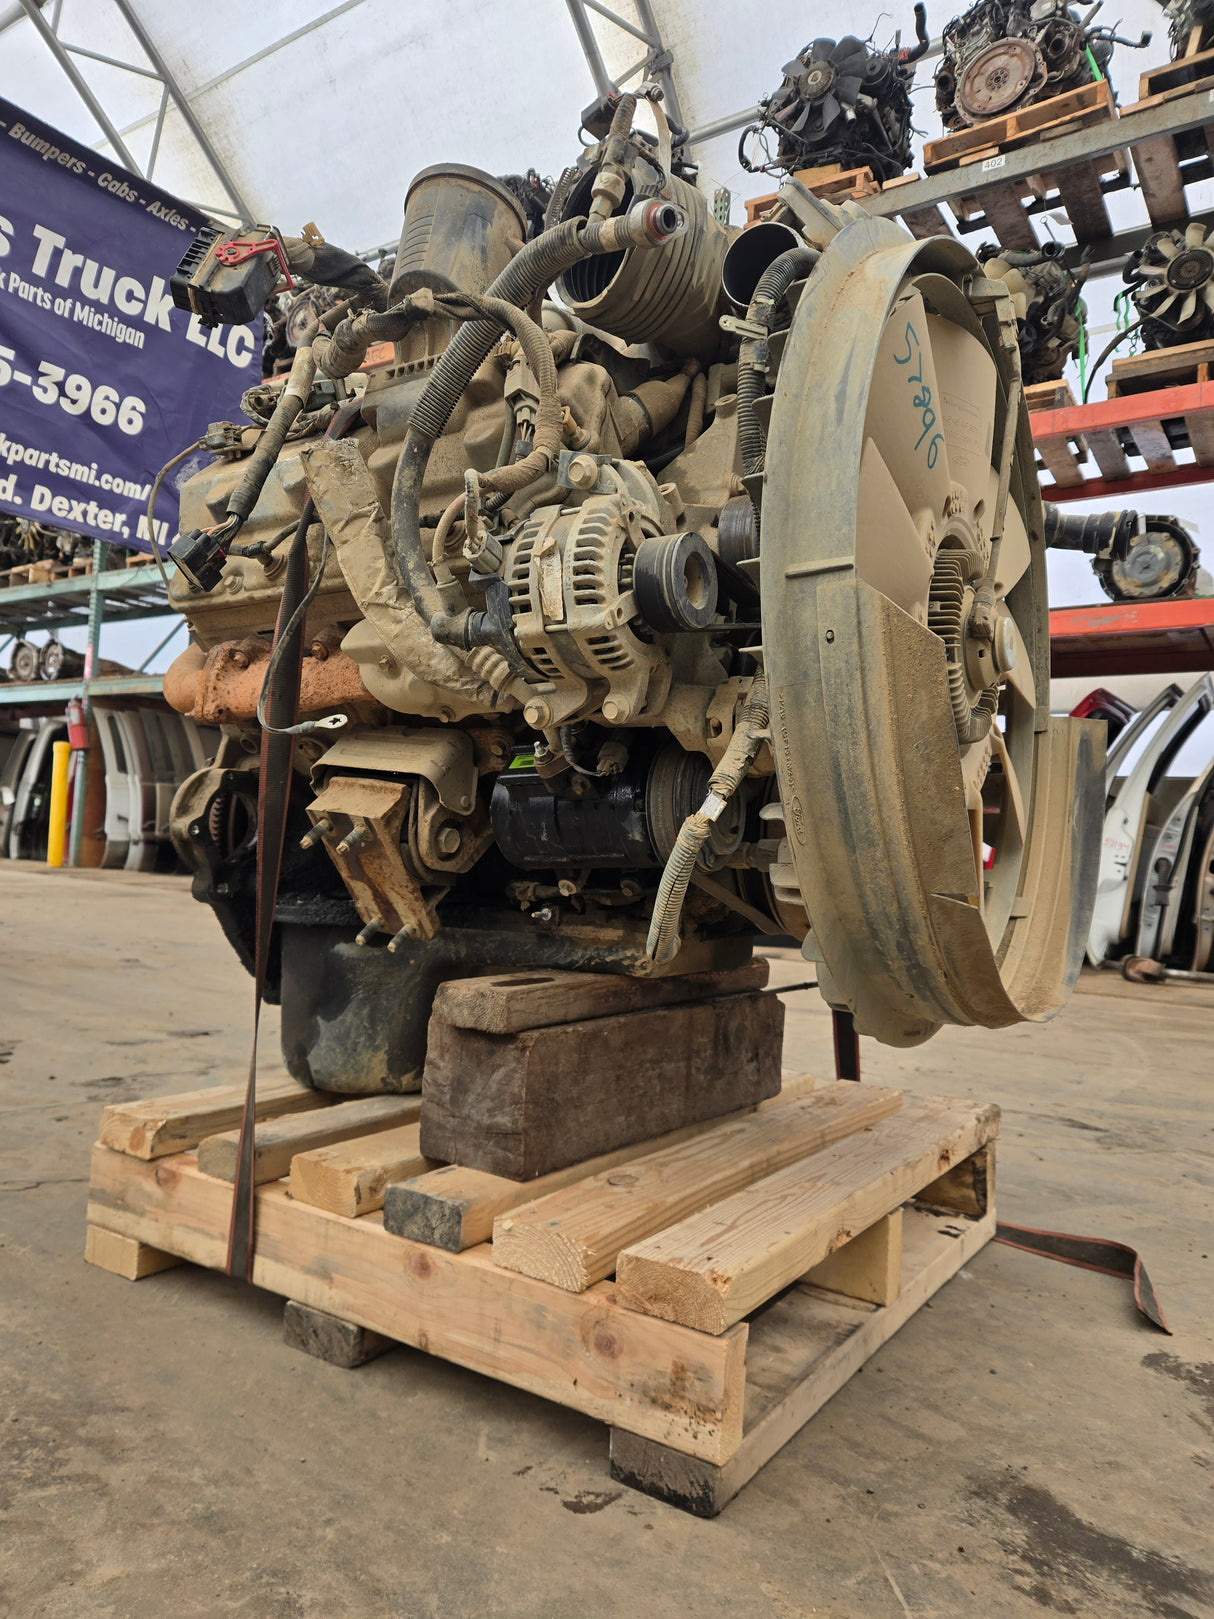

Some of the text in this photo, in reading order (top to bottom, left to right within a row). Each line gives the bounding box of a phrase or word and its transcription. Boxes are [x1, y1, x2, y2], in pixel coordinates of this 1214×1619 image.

[8, 122, 86, 174] Bumpers
[97, 172, 139, 202] Cabs
[146, 201, 188, 232] Axles
[984, 157, 1003, 169] 402
[8, 271, 53, 310] Parts
[53, 297, 73, 319] of
[73, 301, 146, 349] Michigan
[31, 223, 175, 332] Truck
[0, 345, 147, 436] 5-3966
[0, 431, 152, 501] kpartsmi.com/
[30, 484, 130, 539] Dexter,
[136, 514, 169, 546] MI
